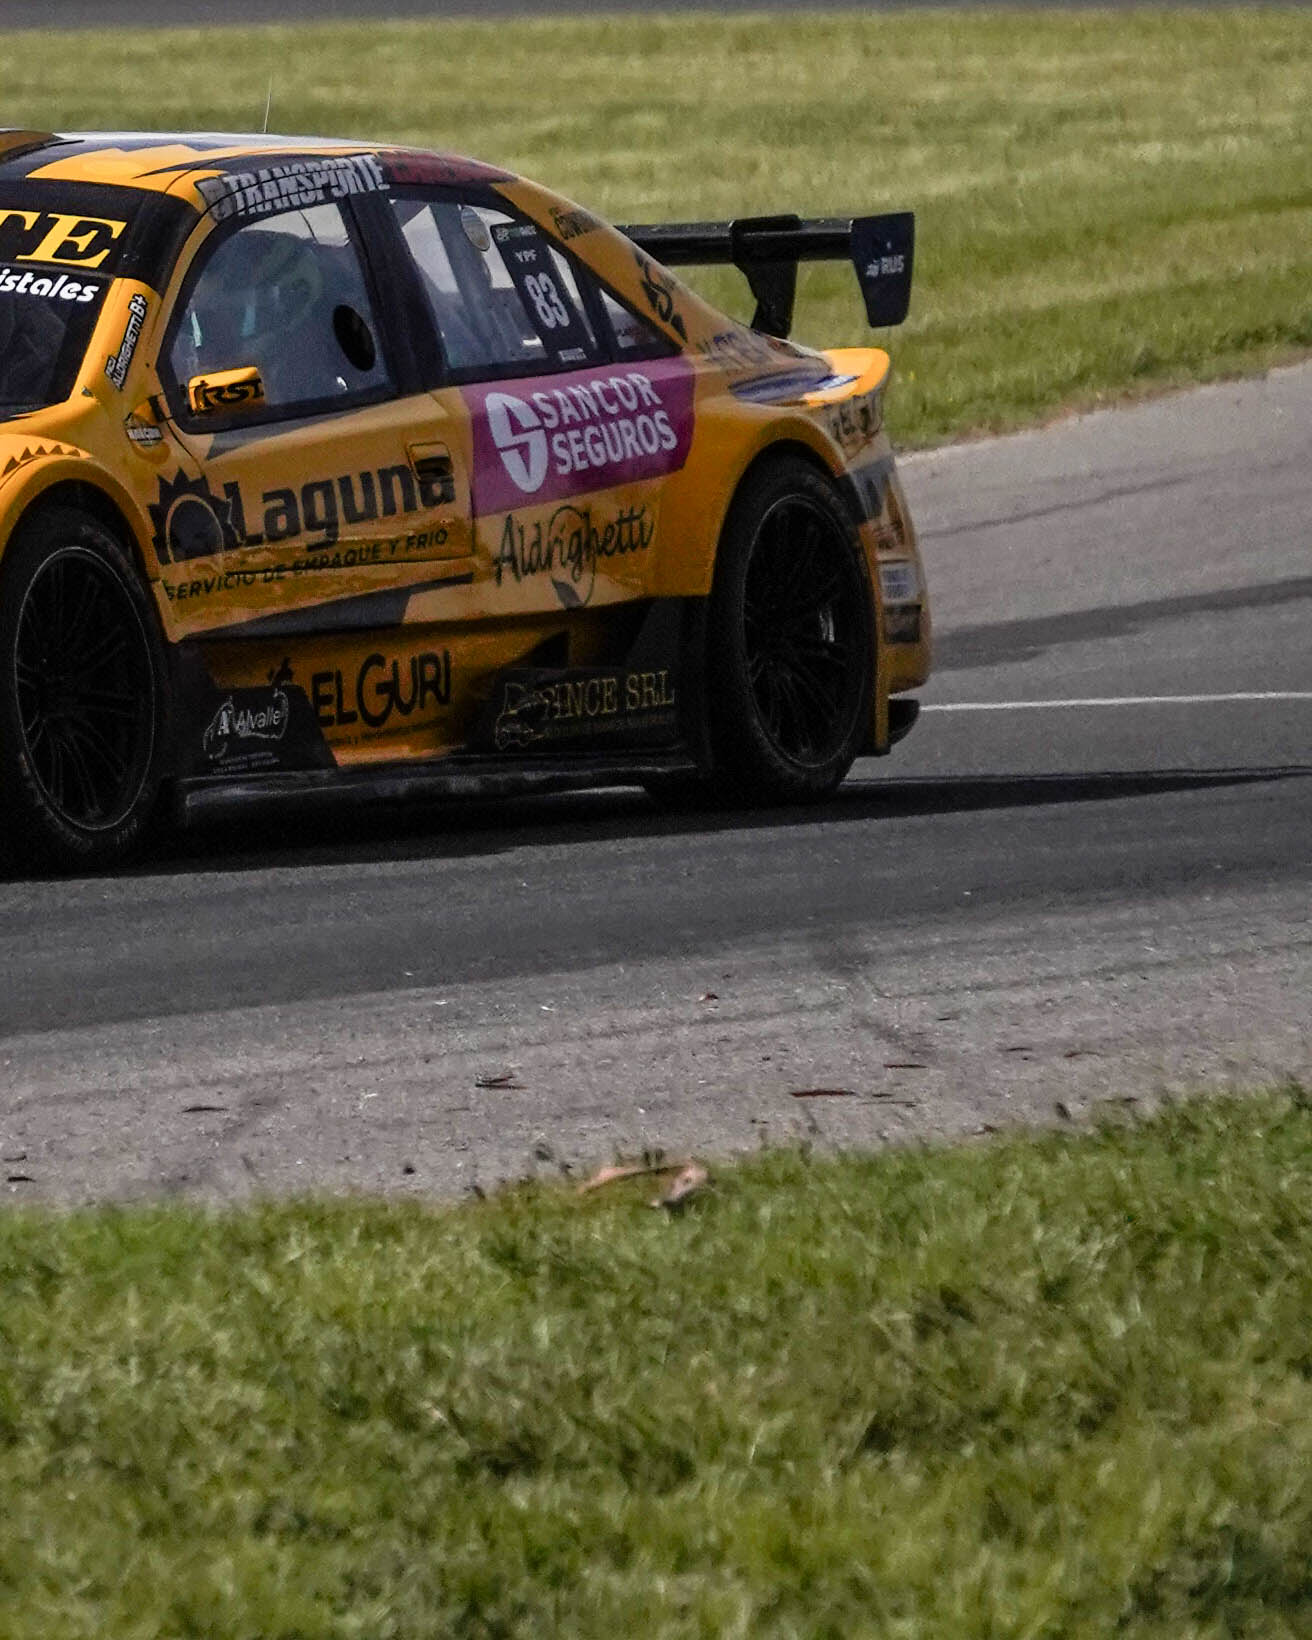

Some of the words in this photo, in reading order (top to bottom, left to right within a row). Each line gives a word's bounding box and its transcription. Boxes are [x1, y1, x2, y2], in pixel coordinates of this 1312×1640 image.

[223, 154, 390, 216] TRANSPORTE
[524, 273, 570, 329] 83
[530, 374, 662, 428] SANCOR
[552, 408, 678, 475] SEGUROS
[223, 463, 456, 552] Laguna
[167, 572, 256, 601] SERVICIO
[264, 566, 288, 582] DE
[388, 540, 398, 554] Y
[406, 528, 448, 550] FRIO
[237, 705, 282, 733] Alvalle
[626, 670, 676, 710] SRL
